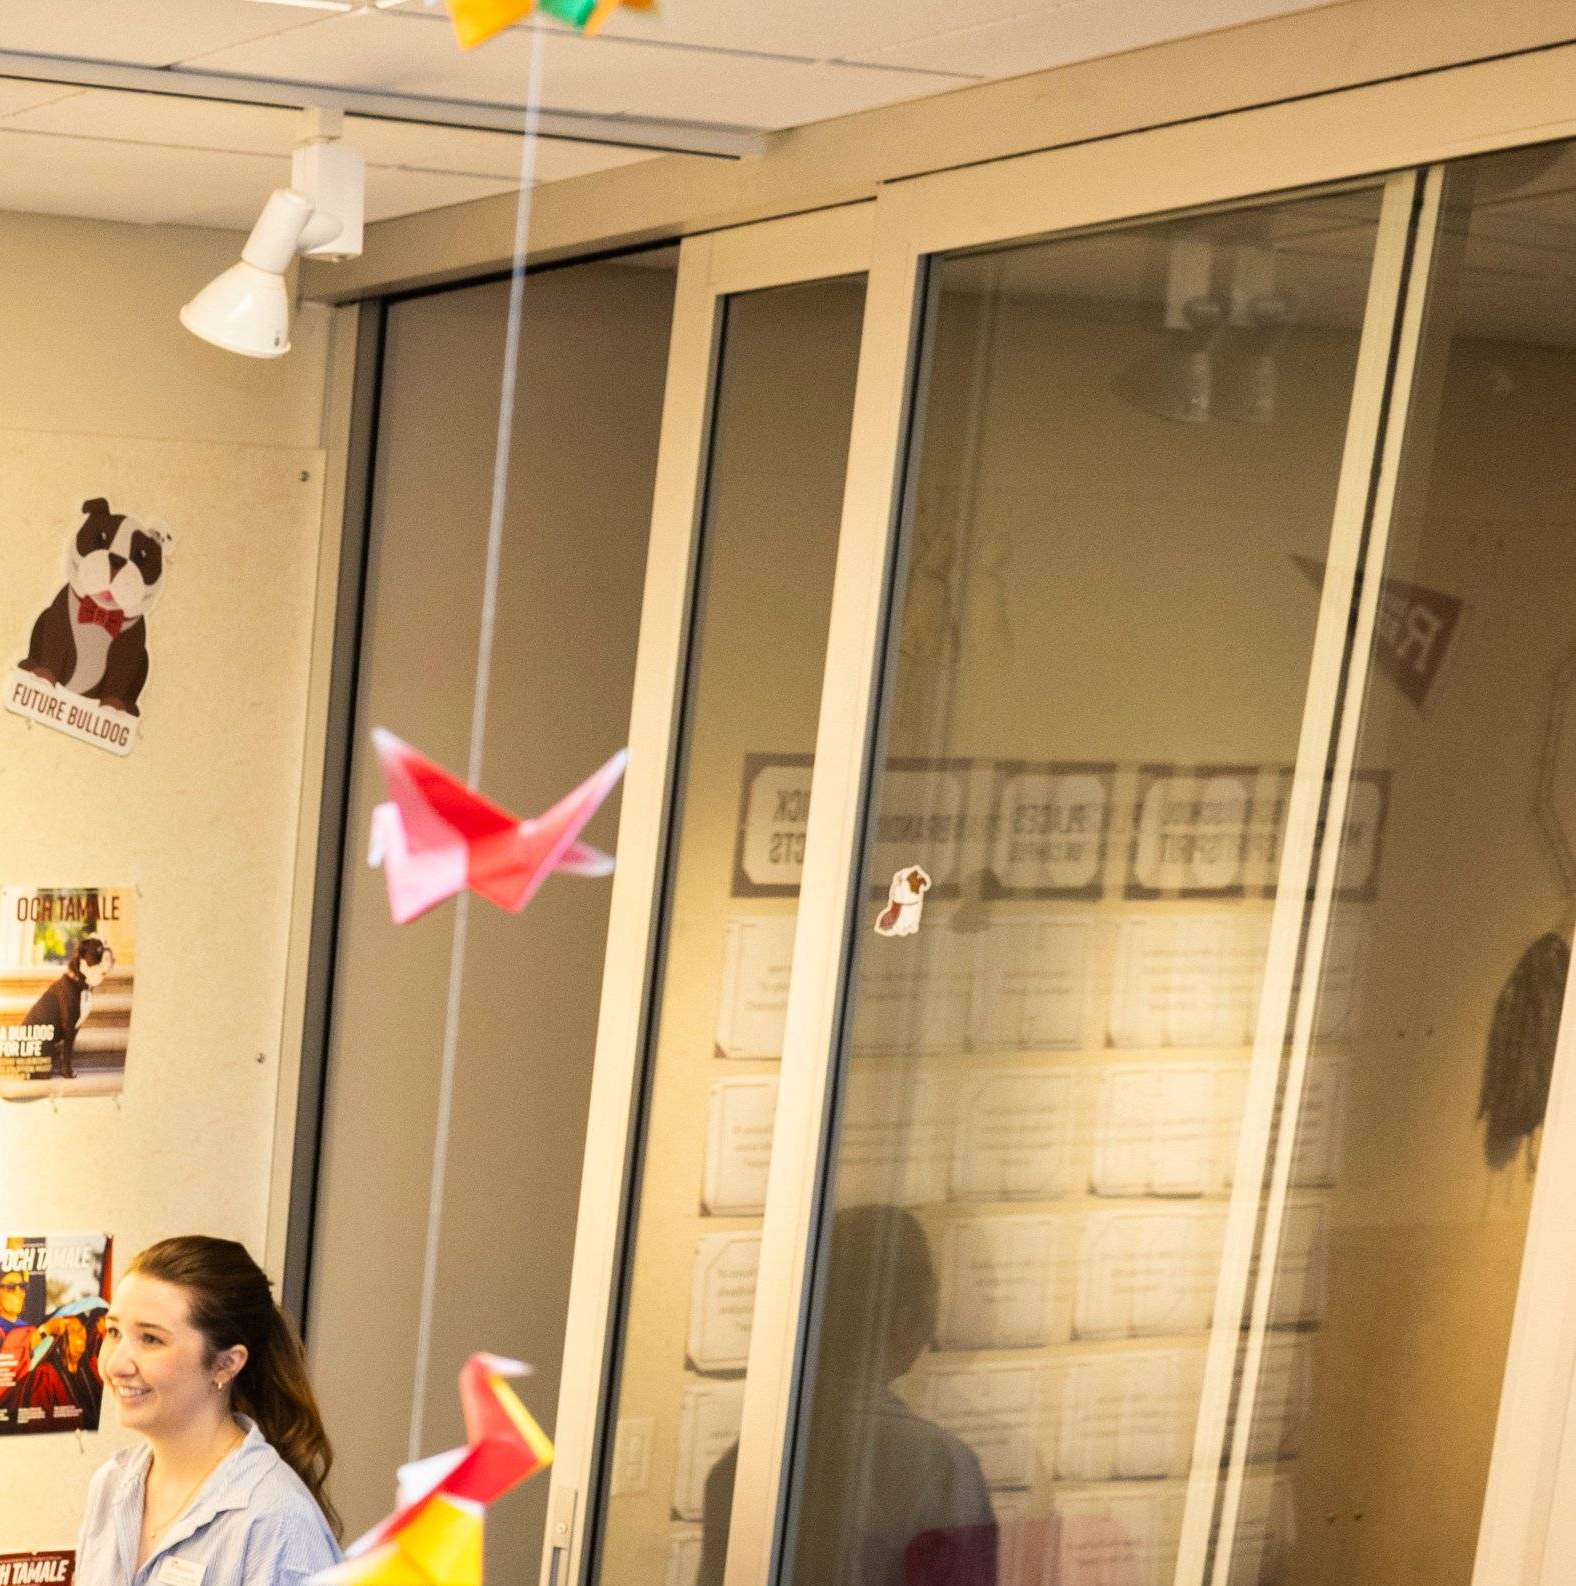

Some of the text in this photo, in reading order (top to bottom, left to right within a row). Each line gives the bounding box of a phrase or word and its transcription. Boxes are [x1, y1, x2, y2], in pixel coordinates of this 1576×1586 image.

[12, 683, 129, 747] FUTURE BULLDOG
[17, 895, 120, 922] OCH TAMALE
[1, 1248, 36, 1272] OCH
[13, 1560, 68, 1584] TAMALE
